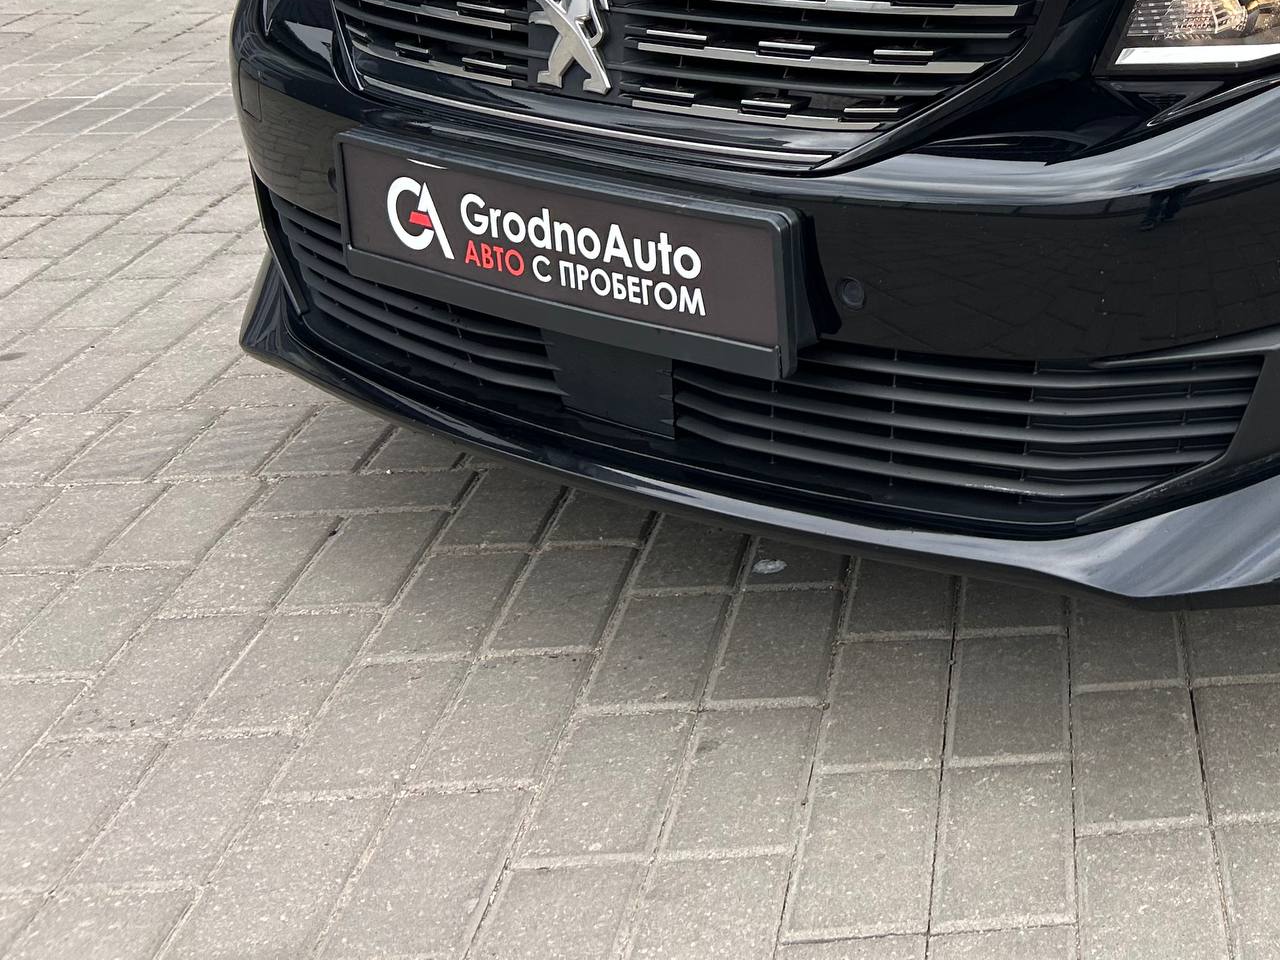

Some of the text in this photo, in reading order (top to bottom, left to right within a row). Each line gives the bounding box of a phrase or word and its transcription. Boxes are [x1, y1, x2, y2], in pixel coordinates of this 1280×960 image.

[460, 193, 701, 280] GrodnoAuto
[465, 239, 707, 317] АВТО С ПРОБЕГОМ
